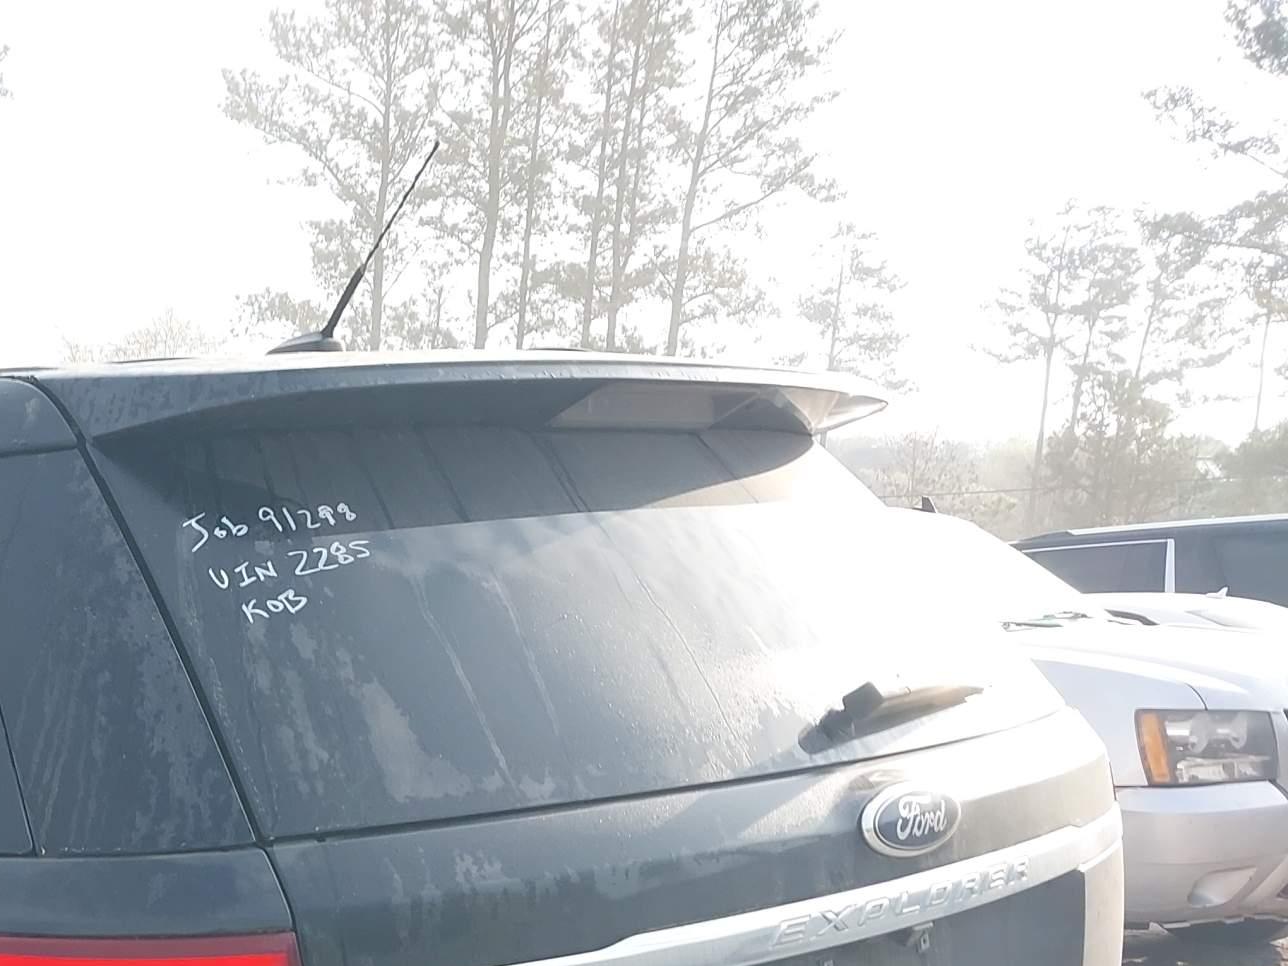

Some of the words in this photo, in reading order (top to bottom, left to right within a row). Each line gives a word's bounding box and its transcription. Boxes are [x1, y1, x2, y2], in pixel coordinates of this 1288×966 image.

[182, 512, 248, 552] Job
[287, 540, 370, 575] 2285
[896, 793, 948, 841] Ford
[771, 855, 1030, 948] EXPLORER
